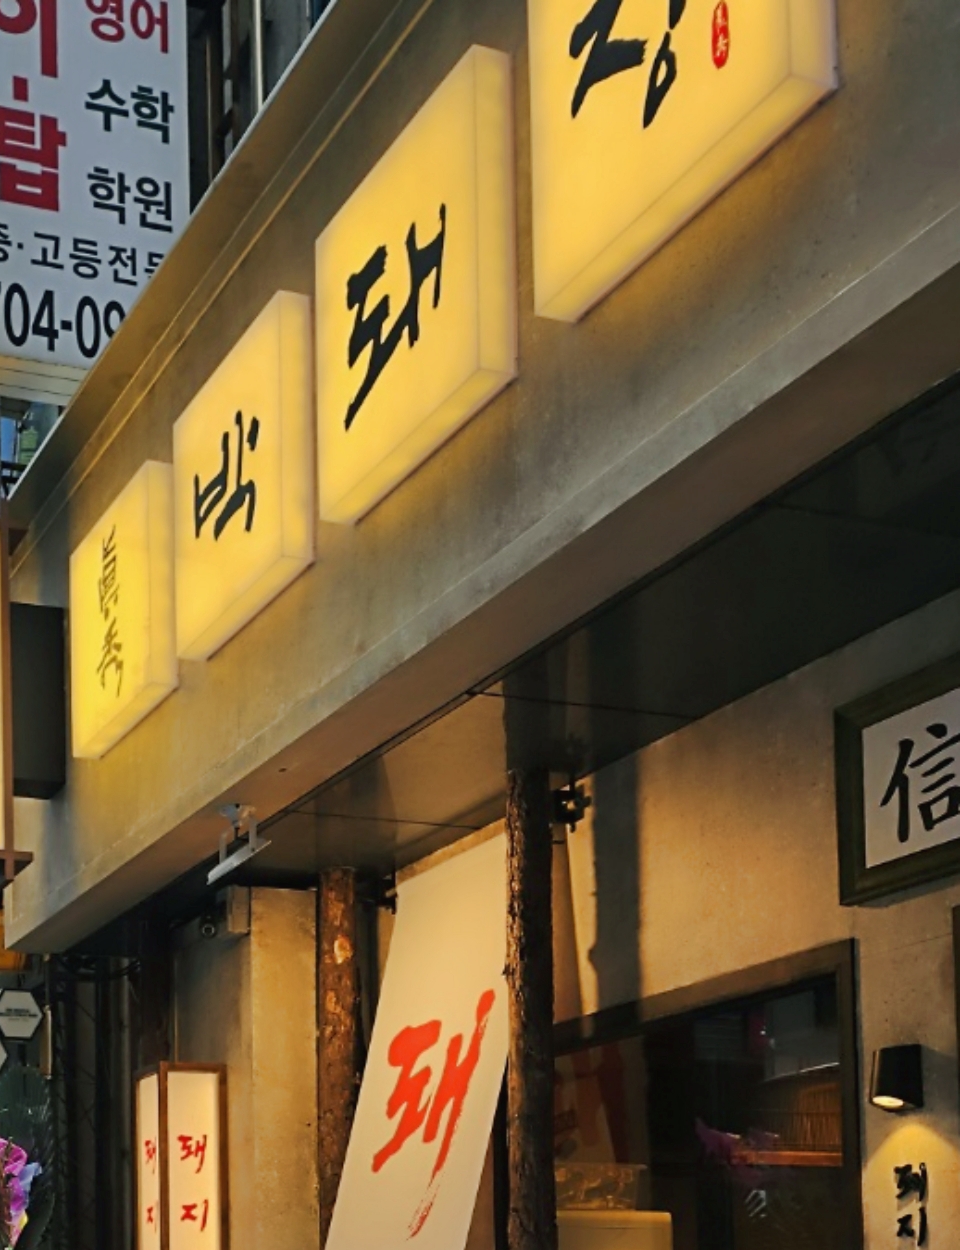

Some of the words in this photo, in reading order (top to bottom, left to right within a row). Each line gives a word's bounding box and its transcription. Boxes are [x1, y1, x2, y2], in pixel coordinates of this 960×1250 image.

[84, 79, 175, 145] 수학
[87, 167, 174, 233] 학원
[195, 410, 260, 542] 박
[880, 723, 960, 843] 信
[177, 1134, 209, 1233] 돼지
